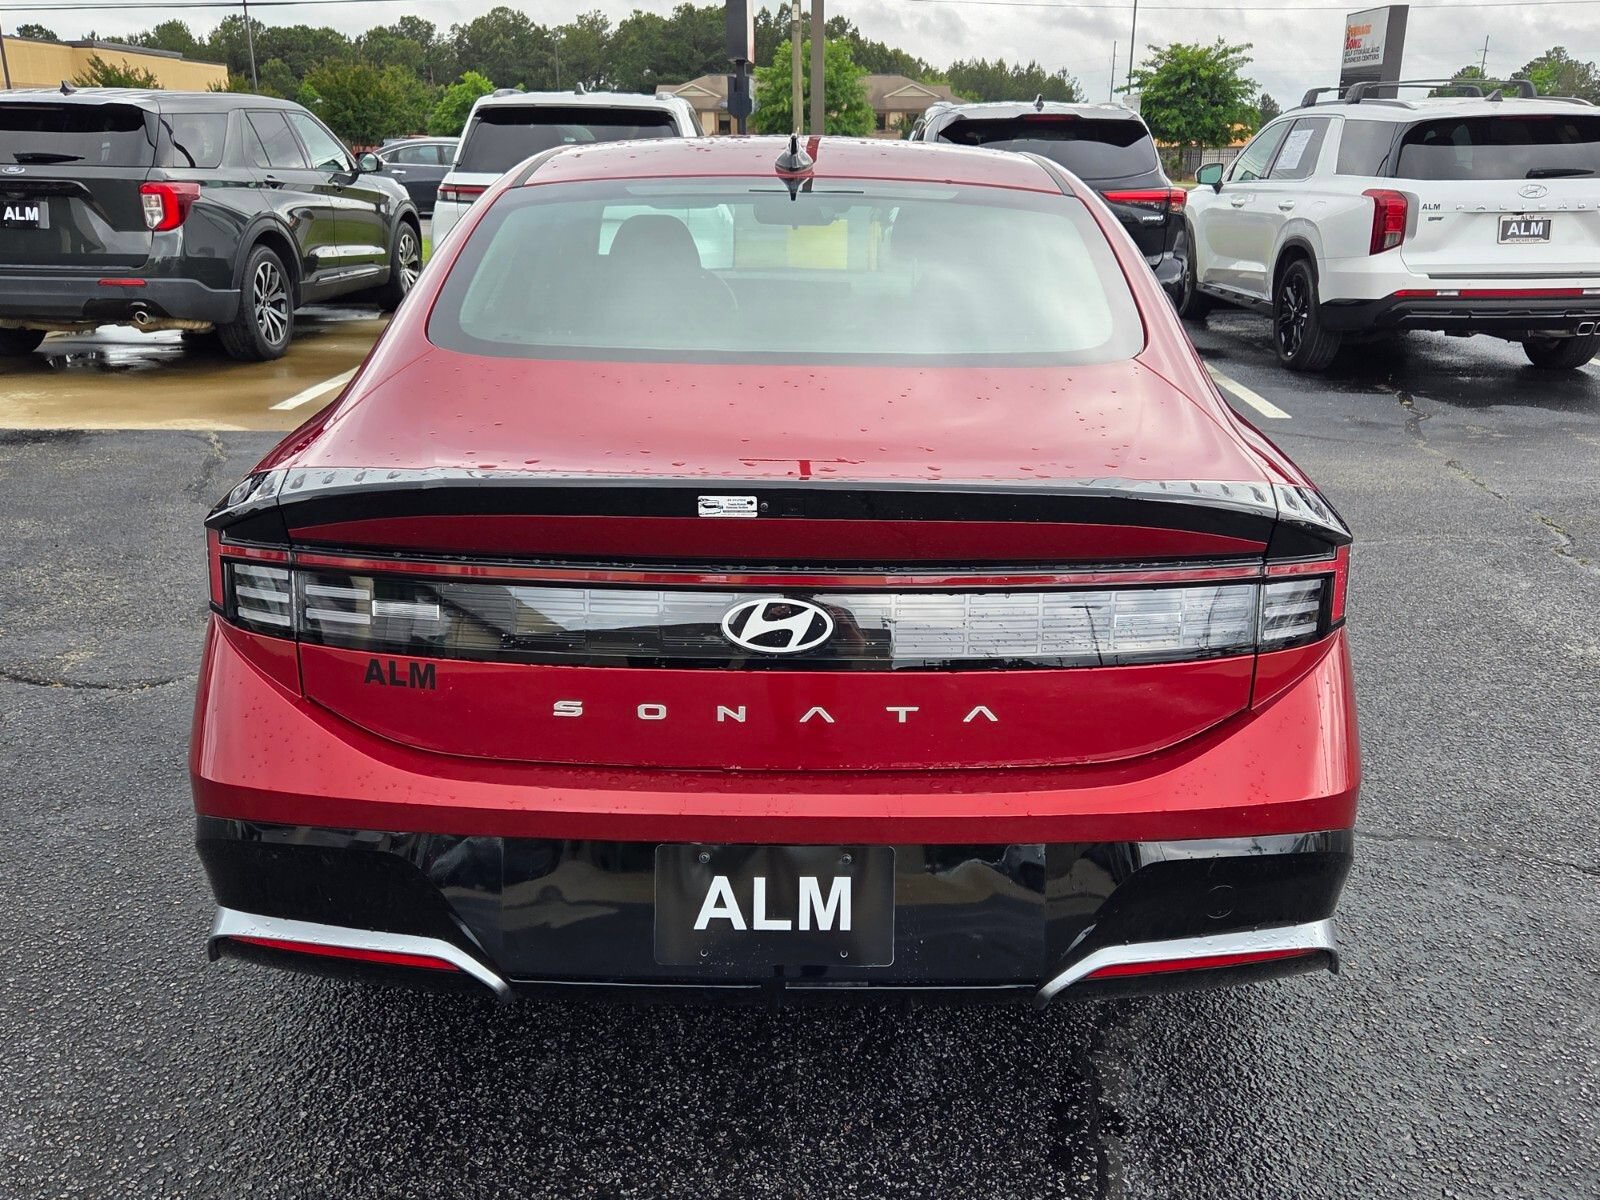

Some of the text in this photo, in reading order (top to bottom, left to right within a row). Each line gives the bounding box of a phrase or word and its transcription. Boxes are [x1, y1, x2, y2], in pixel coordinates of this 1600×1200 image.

[3, 206, 39, 221] ALM
[1507, 221, 1544, 236] ALM
[363, 658, 437, 690] ALM
[553, 700, 999, 723] SONATA
[693, 875, 852, 931] ALM
